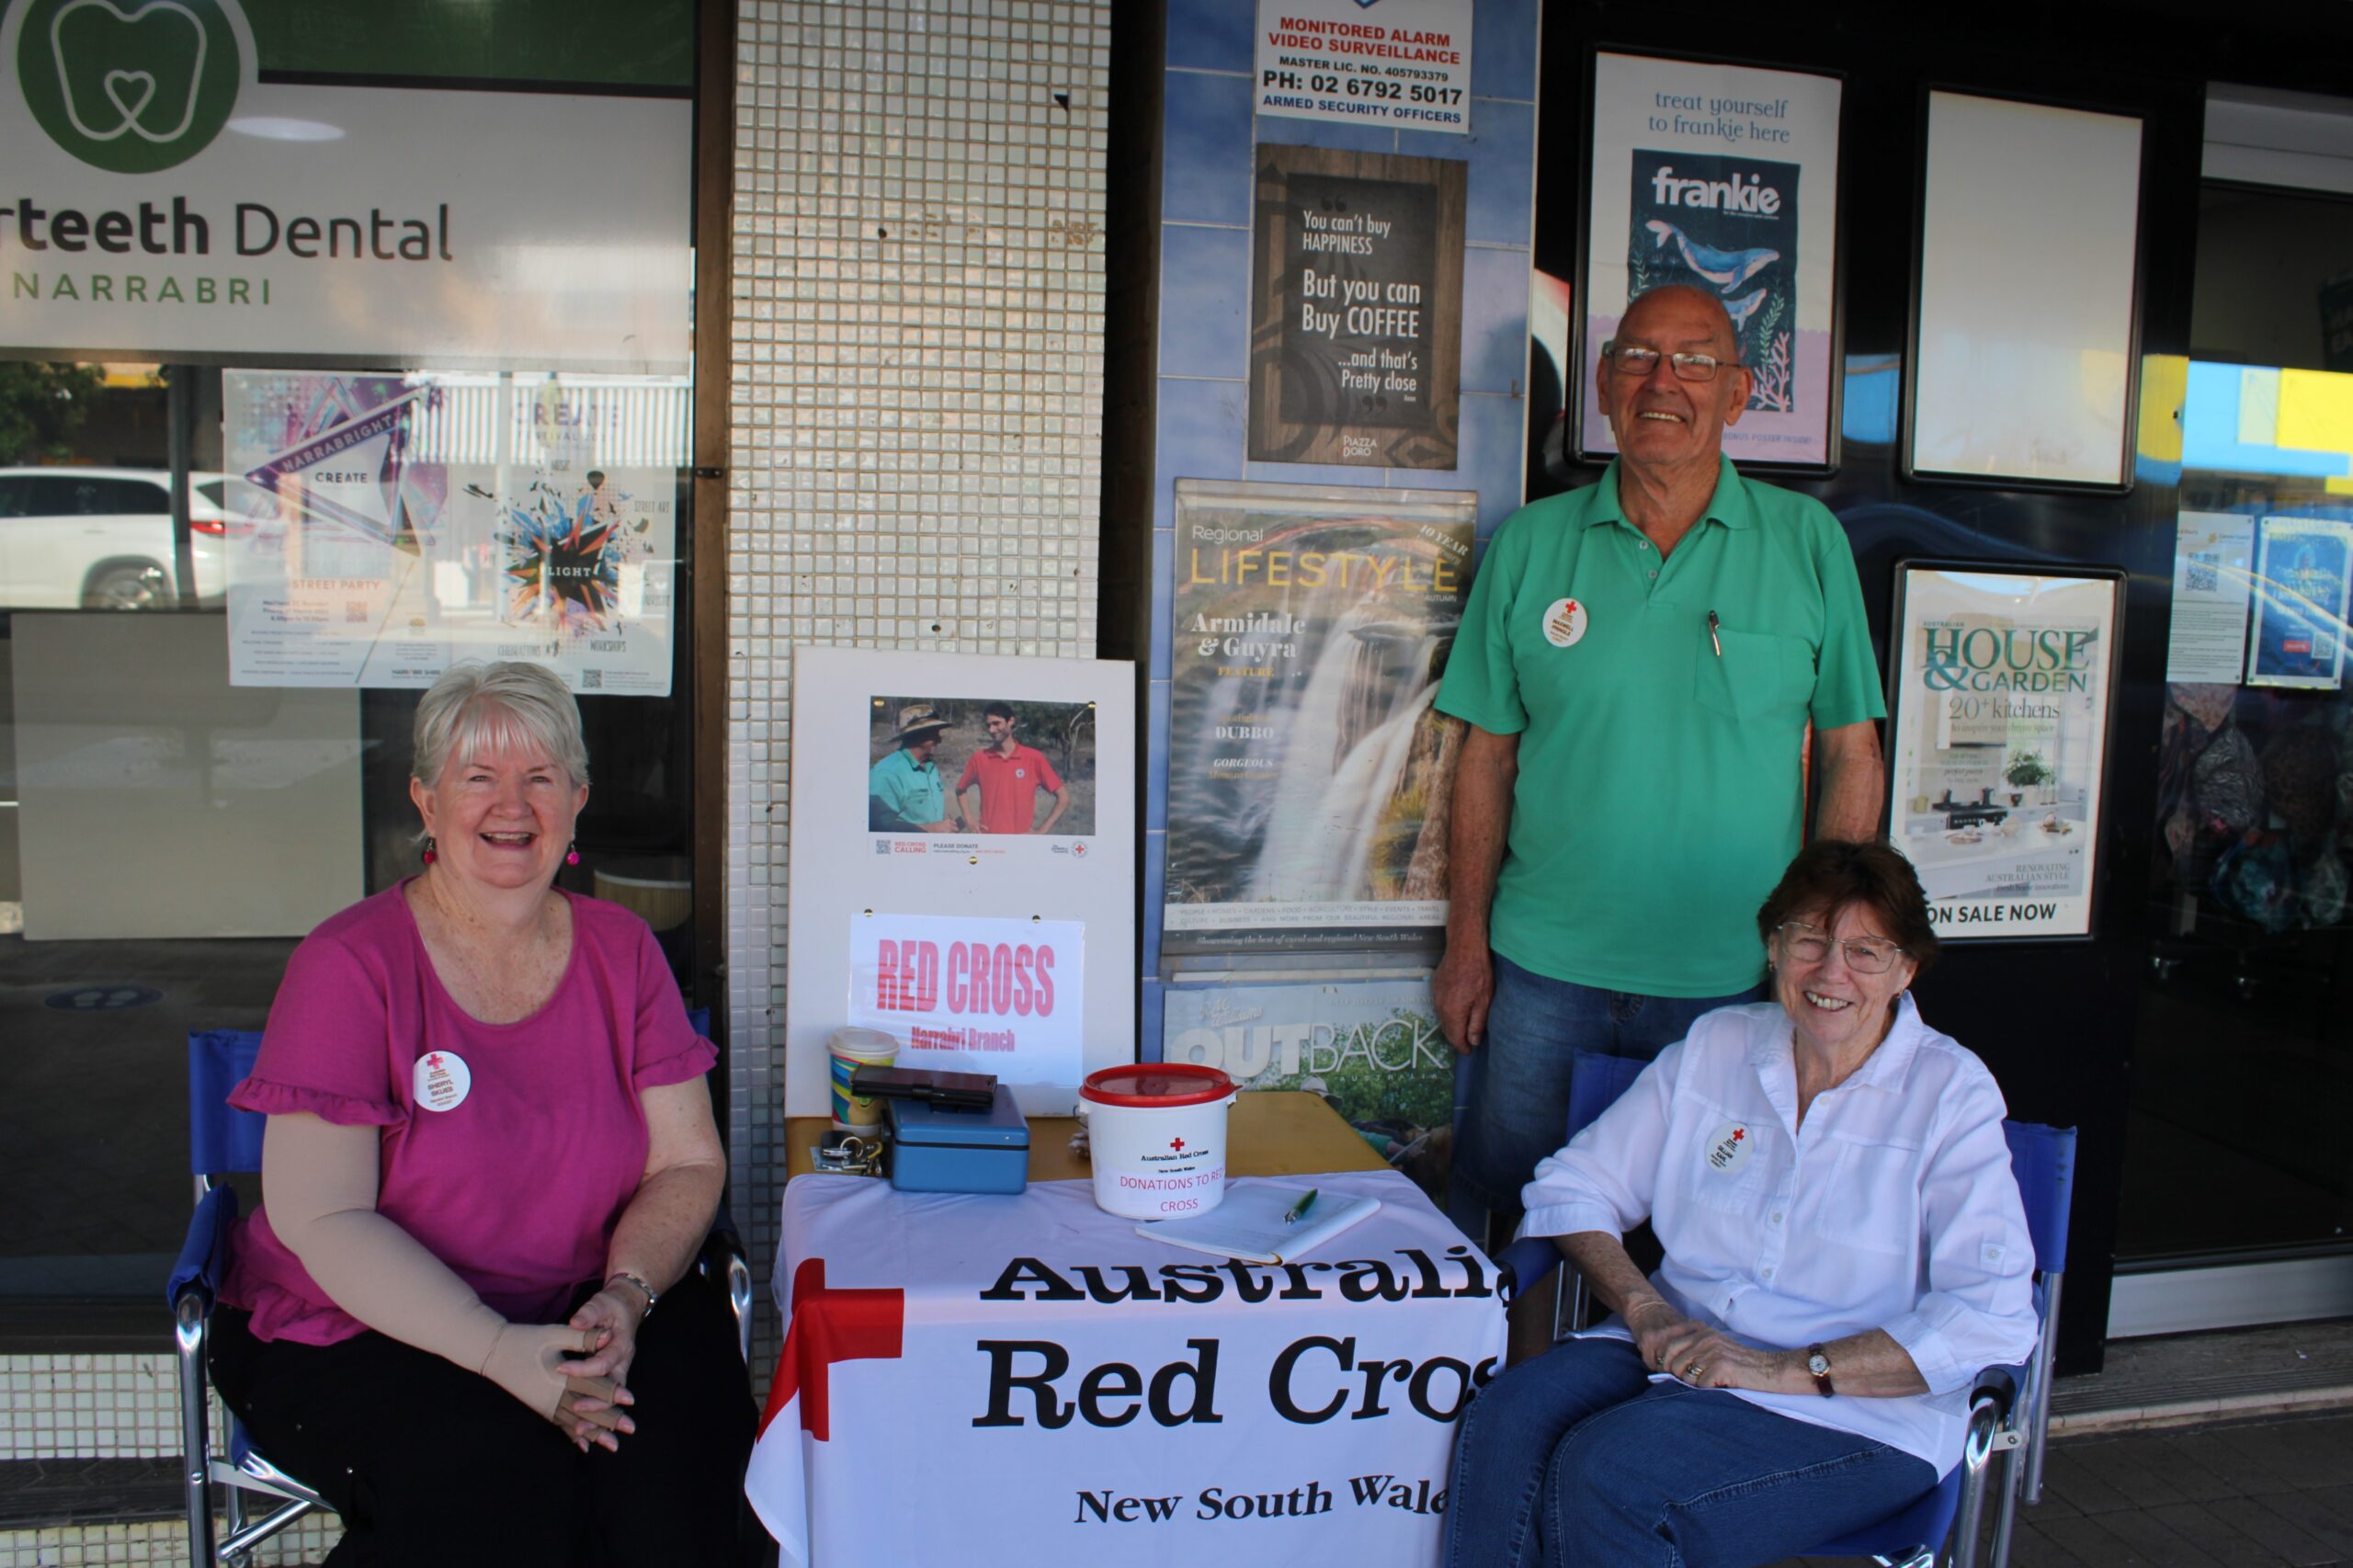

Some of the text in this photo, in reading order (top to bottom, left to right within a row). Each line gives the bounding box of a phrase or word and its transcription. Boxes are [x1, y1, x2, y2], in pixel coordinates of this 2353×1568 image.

[1279, 17, 1450, 47] MONITORED ALARM
[1268, 32, 1461, 65] VIDEO SURVEILLANCE
[1279, 55, 1449, 82] MASTER LIC. NO. 405793379
[1263, 69, 1462, 106] PH: 02 6792 5017
[1263, 95, 1461, 124] ARMED SECURITY OFFICERS
[1655, 92, 1789, 119] treat yourself
[1648, 115, 1790, 143] to frankie here
[1652, 166, 1780, 214] frankie
[236, 202, 453, 262] Dental
[1303, 210, 1391, 239] You can't buy
[1302, 233, 1373, 256] HAPPINESS
[13, 272, 269, 305] NARRABRI
[1303, 268, 1420, 306] But you can
[1302, 303, 1419, 339] Buy COFFEE
[1381, 348, 1418, 370] that's
[1341, 369, 1417, 393] Pretty close
[282, 415, 393, 472] NARRABRIGHT
[1343, 434, 1378, 448] PIAZZA
[1752, 433, 1781, 442] POSTER
[315, 472, 368, 483] CREATE
[1192, 525, 1264, 544] Regional
[1419, 524, 1469, 556] 10 YEAR
[1191, 548, 1459, 593] LIFESTYLE
[292, 579, 381, 590] STREET PARTY
[1191, 612, 1306, 634] Armidale
[1198, 636, 1297, 663] & Guyra
[1920, 628, 2090, 671] HOUSE
[1923, 649, 2087, 692] & GARDEN
[1948, 696, 2060, 720] 20+ kitchens
[1215, 725, 1275, 739] DUBBO
[1213, 757, 1274, 767] GORGEOUS
[2016, 862, 2071, 873] RENOVATING
[1927, 903, 2057, 924] ON SALE NOW
[876, 938, 1055, 1017] RED CROSS
[968, 1028, 1015, 1052] Branch
[1171, 1018, 1447, 1078] OUTBACK
[1193, 1149, 1209, 1157] Cross
[1120, 1176, 1193, 1190] DONATIONS
[1196, 1175, 1210, 1187] TO
[1160, 1198, 1199, 1212] CROSS
[972, 1335, 1498, 1430] Red Cro
[1074, 1474, 1449, 1523] New South Wale
